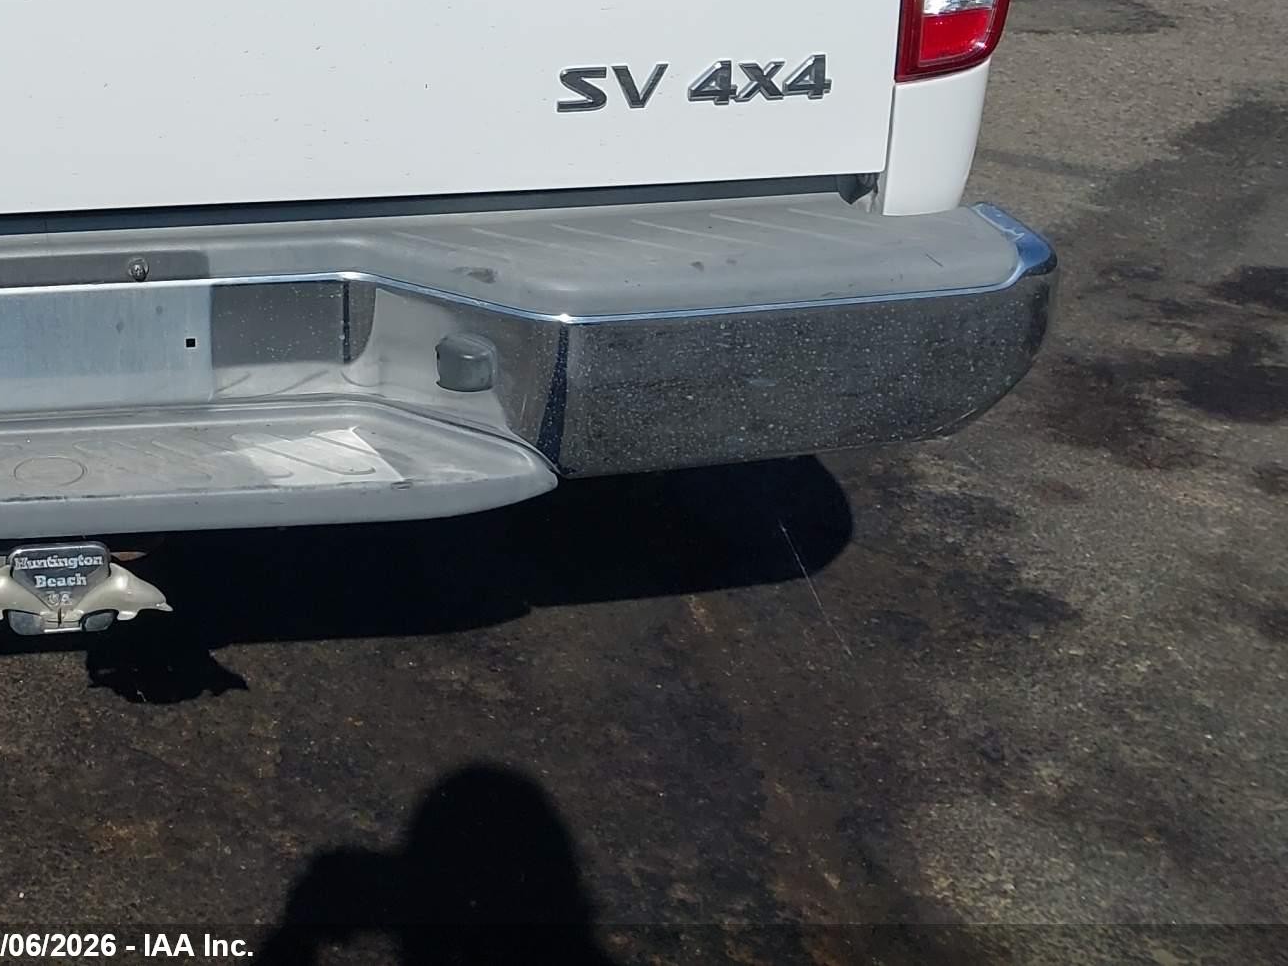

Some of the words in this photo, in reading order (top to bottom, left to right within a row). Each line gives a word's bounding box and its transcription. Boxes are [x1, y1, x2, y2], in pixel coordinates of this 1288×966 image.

[556, 63, 669, 113] SV
[14, 554, 104, 571] Huntington
[34, 573, 87, 588] Beach
